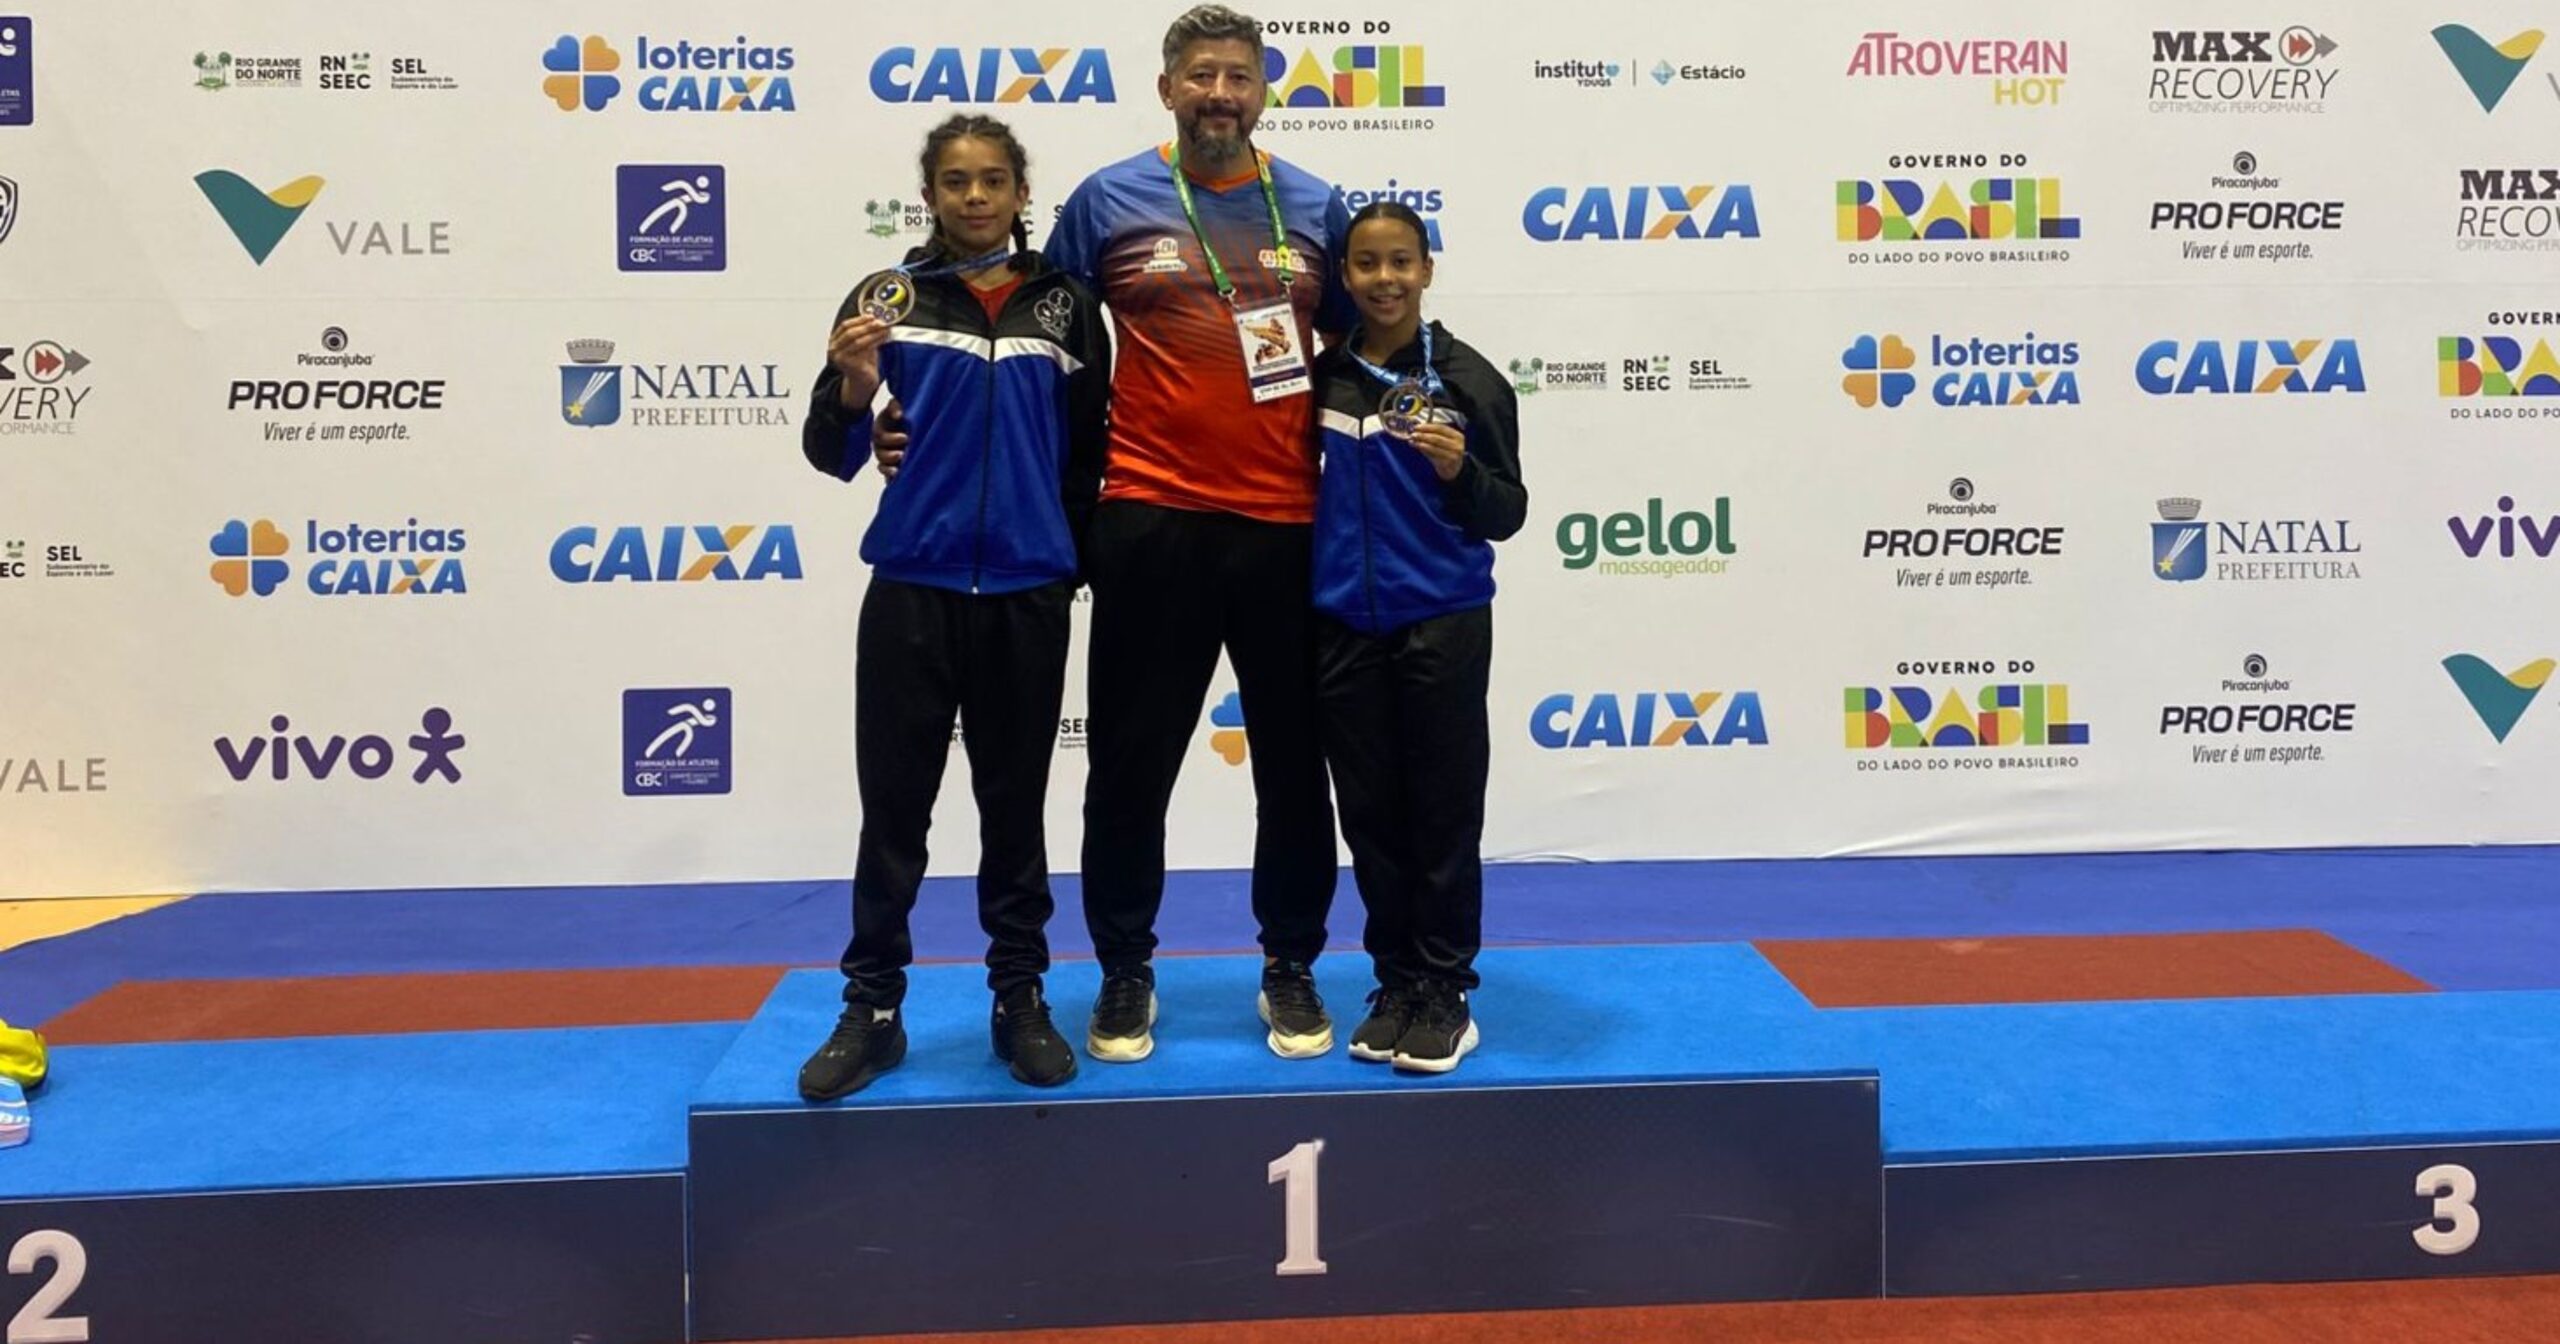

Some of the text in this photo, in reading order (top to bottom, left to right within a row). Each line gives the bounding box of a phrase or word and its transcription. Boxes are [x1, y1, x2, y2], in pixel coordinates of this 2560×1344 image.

[1364, 21, 1390, 33] DO
[638, 36, 794, 70] loterias
[1847, 33, 2067, 76] ATROVERAN
[2153, 31, 2272, 62] MAX
[235, 58, 300, 67] RIO GRANDE
[321, 56, 345, 71] RN
[392, 59, 426, 73] SEL
[236, 67, 301, 80] DO NORTE
[320, 74, 370, 89] SEEC
[870, 47, 1116, 103] CAIXA
[1264, 45, 1445, 108] RASIL
[1681, 66, 1745, 79] Estácio
[1578, 79, 1611, 87] YDUQS
[1994, 78, 2065, 105] HOT
[2149, 68, 2338, 99] RECOVERY
[639, 77, 795, 111] CAIXA
[2148, 101, 2325, 114] OPTIMIZING PERFORMANCE
[1282, 120, 1302, 131] DO
[1309, 120, 1347, 131] POVO
[1354, 119, 1434, 130] BRASILEIRO
[1889, 154, 2026, 168] GOVERNO DO
[2212, 176, 2278, 190] Piracanjuba
[1333, 179, 1443, 212] terias
[905, 205, 921, 214] RIO
[1523, 186, 1760, 242] CAIXA
[1836, 178, 2080, 241] BRASIL
[905, 216, 922, 226] DO
[2457, 206, 2560, 237] RECO
[326, 221, 450, 255] VALE
[630, 249, 656, 262] CBC
[1849, 251, 2069, 264] DO LADO DO POVO BRASILEIRO
[2183, 241, 2312, 262] Viver é um esporte.
[2488, 312, 2560, 325] GOVER
[1933, 332, 2079, 366] loterias
[298, 351, 372, 367] Piracanjuba
[1546, 362, 1606, 372] RIO GRANDE
[1624, 360, 1648, 374] RN
[1690, 360, 1722, 375] SEL
[2135, 340, 2366, 395] CAIXA
[2437, 336, 2560, 397] BRA
[632, 365, 789, 398] NATAL
[1546, 373, 1605, 383] DO NORTE
[1623, 376, 1670, 391] SEEC
[1933, 372, 2080, 406] CAIXA
[632, 407, 789, 426] PREFEITURA
[2451, 408, 2560, 419] DO LADO DO PO
[0, 422, 76, 435] ORMANCE
[265, 422, 409, 444] Viver é um esporte.
[1927, 503, 1996, 517] Piracanjuba
[308, 518, 465, 553] loterias
[1556, 497, 1736, 569] gelol
[2448, 496, 2560, 557] viv
[2216, 521, 2360, 554] NATAL
[47, 546, 82, 561] SEL
[550, 526, 803, 583] CAIXA
[0, 562, 25, 578] EC
[308, 559, 466, 595] CAIXA
[1599, 559, 1729, 579] massageador
[1897, 568, 2032, 589] Viver é um esporte.
[2218, 562, 2360, 580] PREFEITURA
[1897, 661, 2034, 675] GOVERNO DO
[2222, 680, 2289, 693] Piracanjuba
[1060, 718, 1085, 733] SE
[1530, 692, 1768, 749] CAIXA
[1844, 684, 2089, 748] BRASIL
[214, 715, 393, 781] vivo
[2193, 744, 2323, 765] Viver é um esporte.
[1857, 757, 2078, 771] DO LADO DO POVO BRASILEIRO
[636, 773, 661, 786] CBC
[1268, 1140, 1327, 1276] 1
[2411, 1163, 2481, 1255] 3
[7, 1230, 90, 1344] 2
